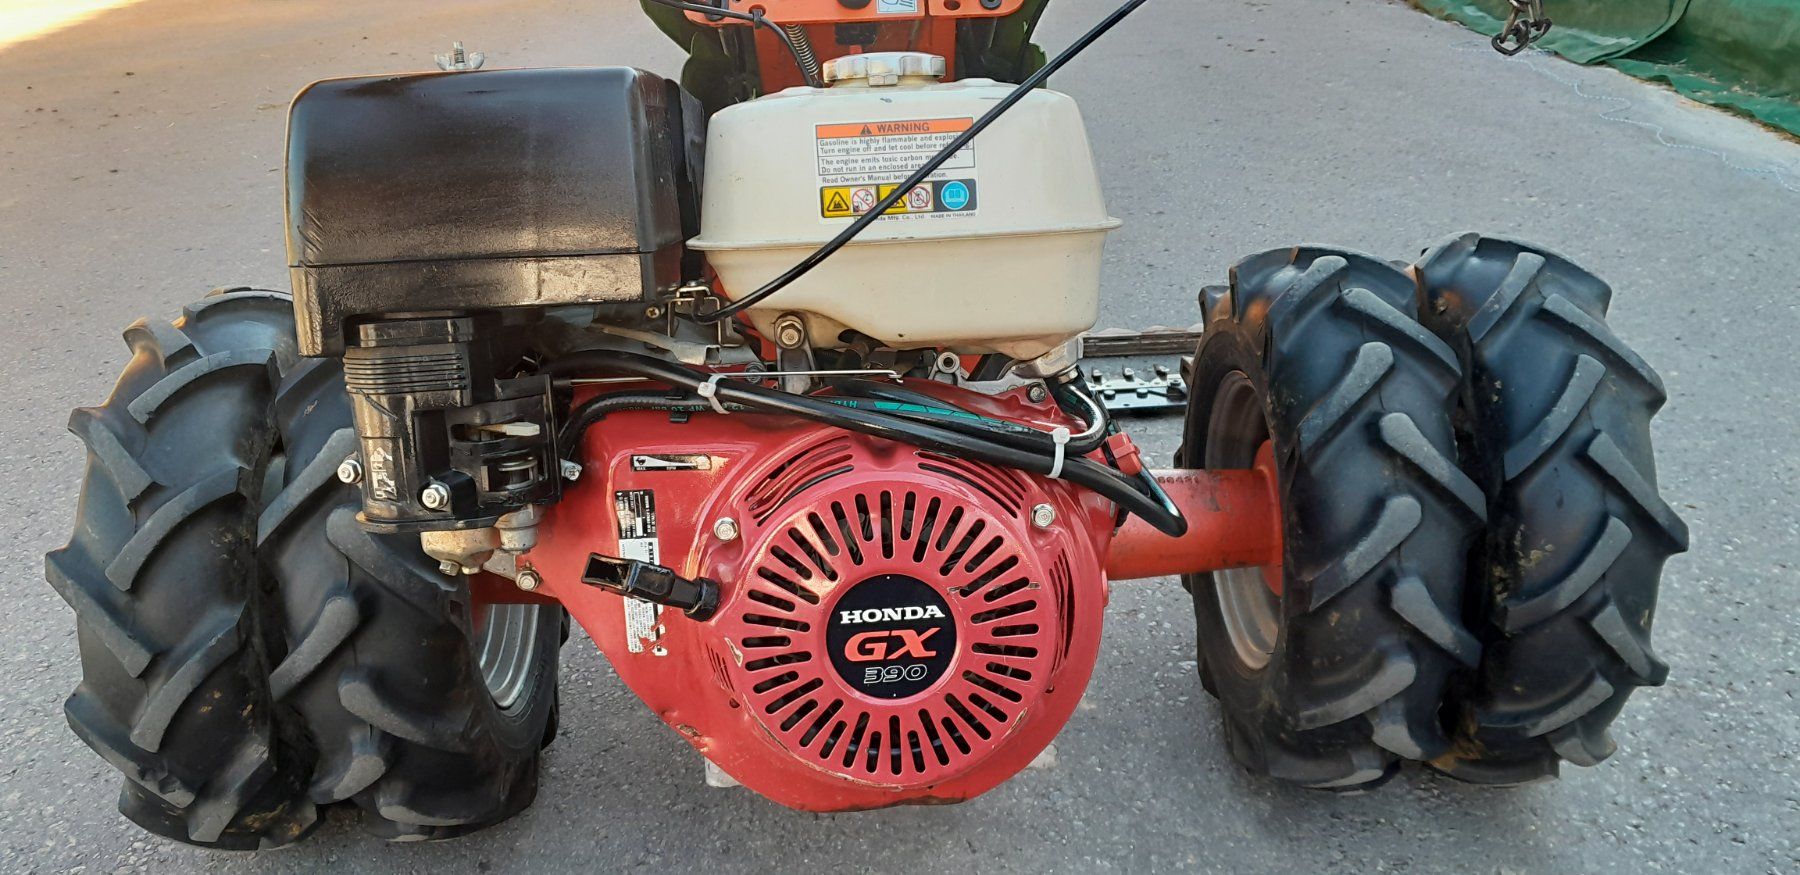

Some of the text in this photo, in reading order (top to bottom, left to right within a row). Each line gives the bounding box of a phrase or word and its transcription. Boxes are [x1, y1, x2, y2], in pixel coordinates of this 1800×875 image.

[877, 122, 930, 133] WARNING
[819, 139, 849, 147] Gasoline
[851, 138, 858, 146] is
[859, 137, 880, 146] highly
[881, 134, 918, 143] flammable
[919, 133, 933, 142] and
[837, 145, 861, 155] engine
[873, 144, 887, 152] and
[915, 142, 937, 150] before
[821, 158, 834, 166] The
[835, 157, 859, 167] engine
[881, 154, 898, 163] toxic
[899, 154, 923, 162] carbon
[821, 166, 831, 174] Do
[878, 162, 909, 171] enclosed
[839, 175, 866, 183] Owner's
[867, 173, 893, 182] Manual
[893, 172, 910, 180] befor
[840, 604, 945, 624] HONDA
[844, 627, 941, 662] GX
[863, 663, 929, 684] 390
